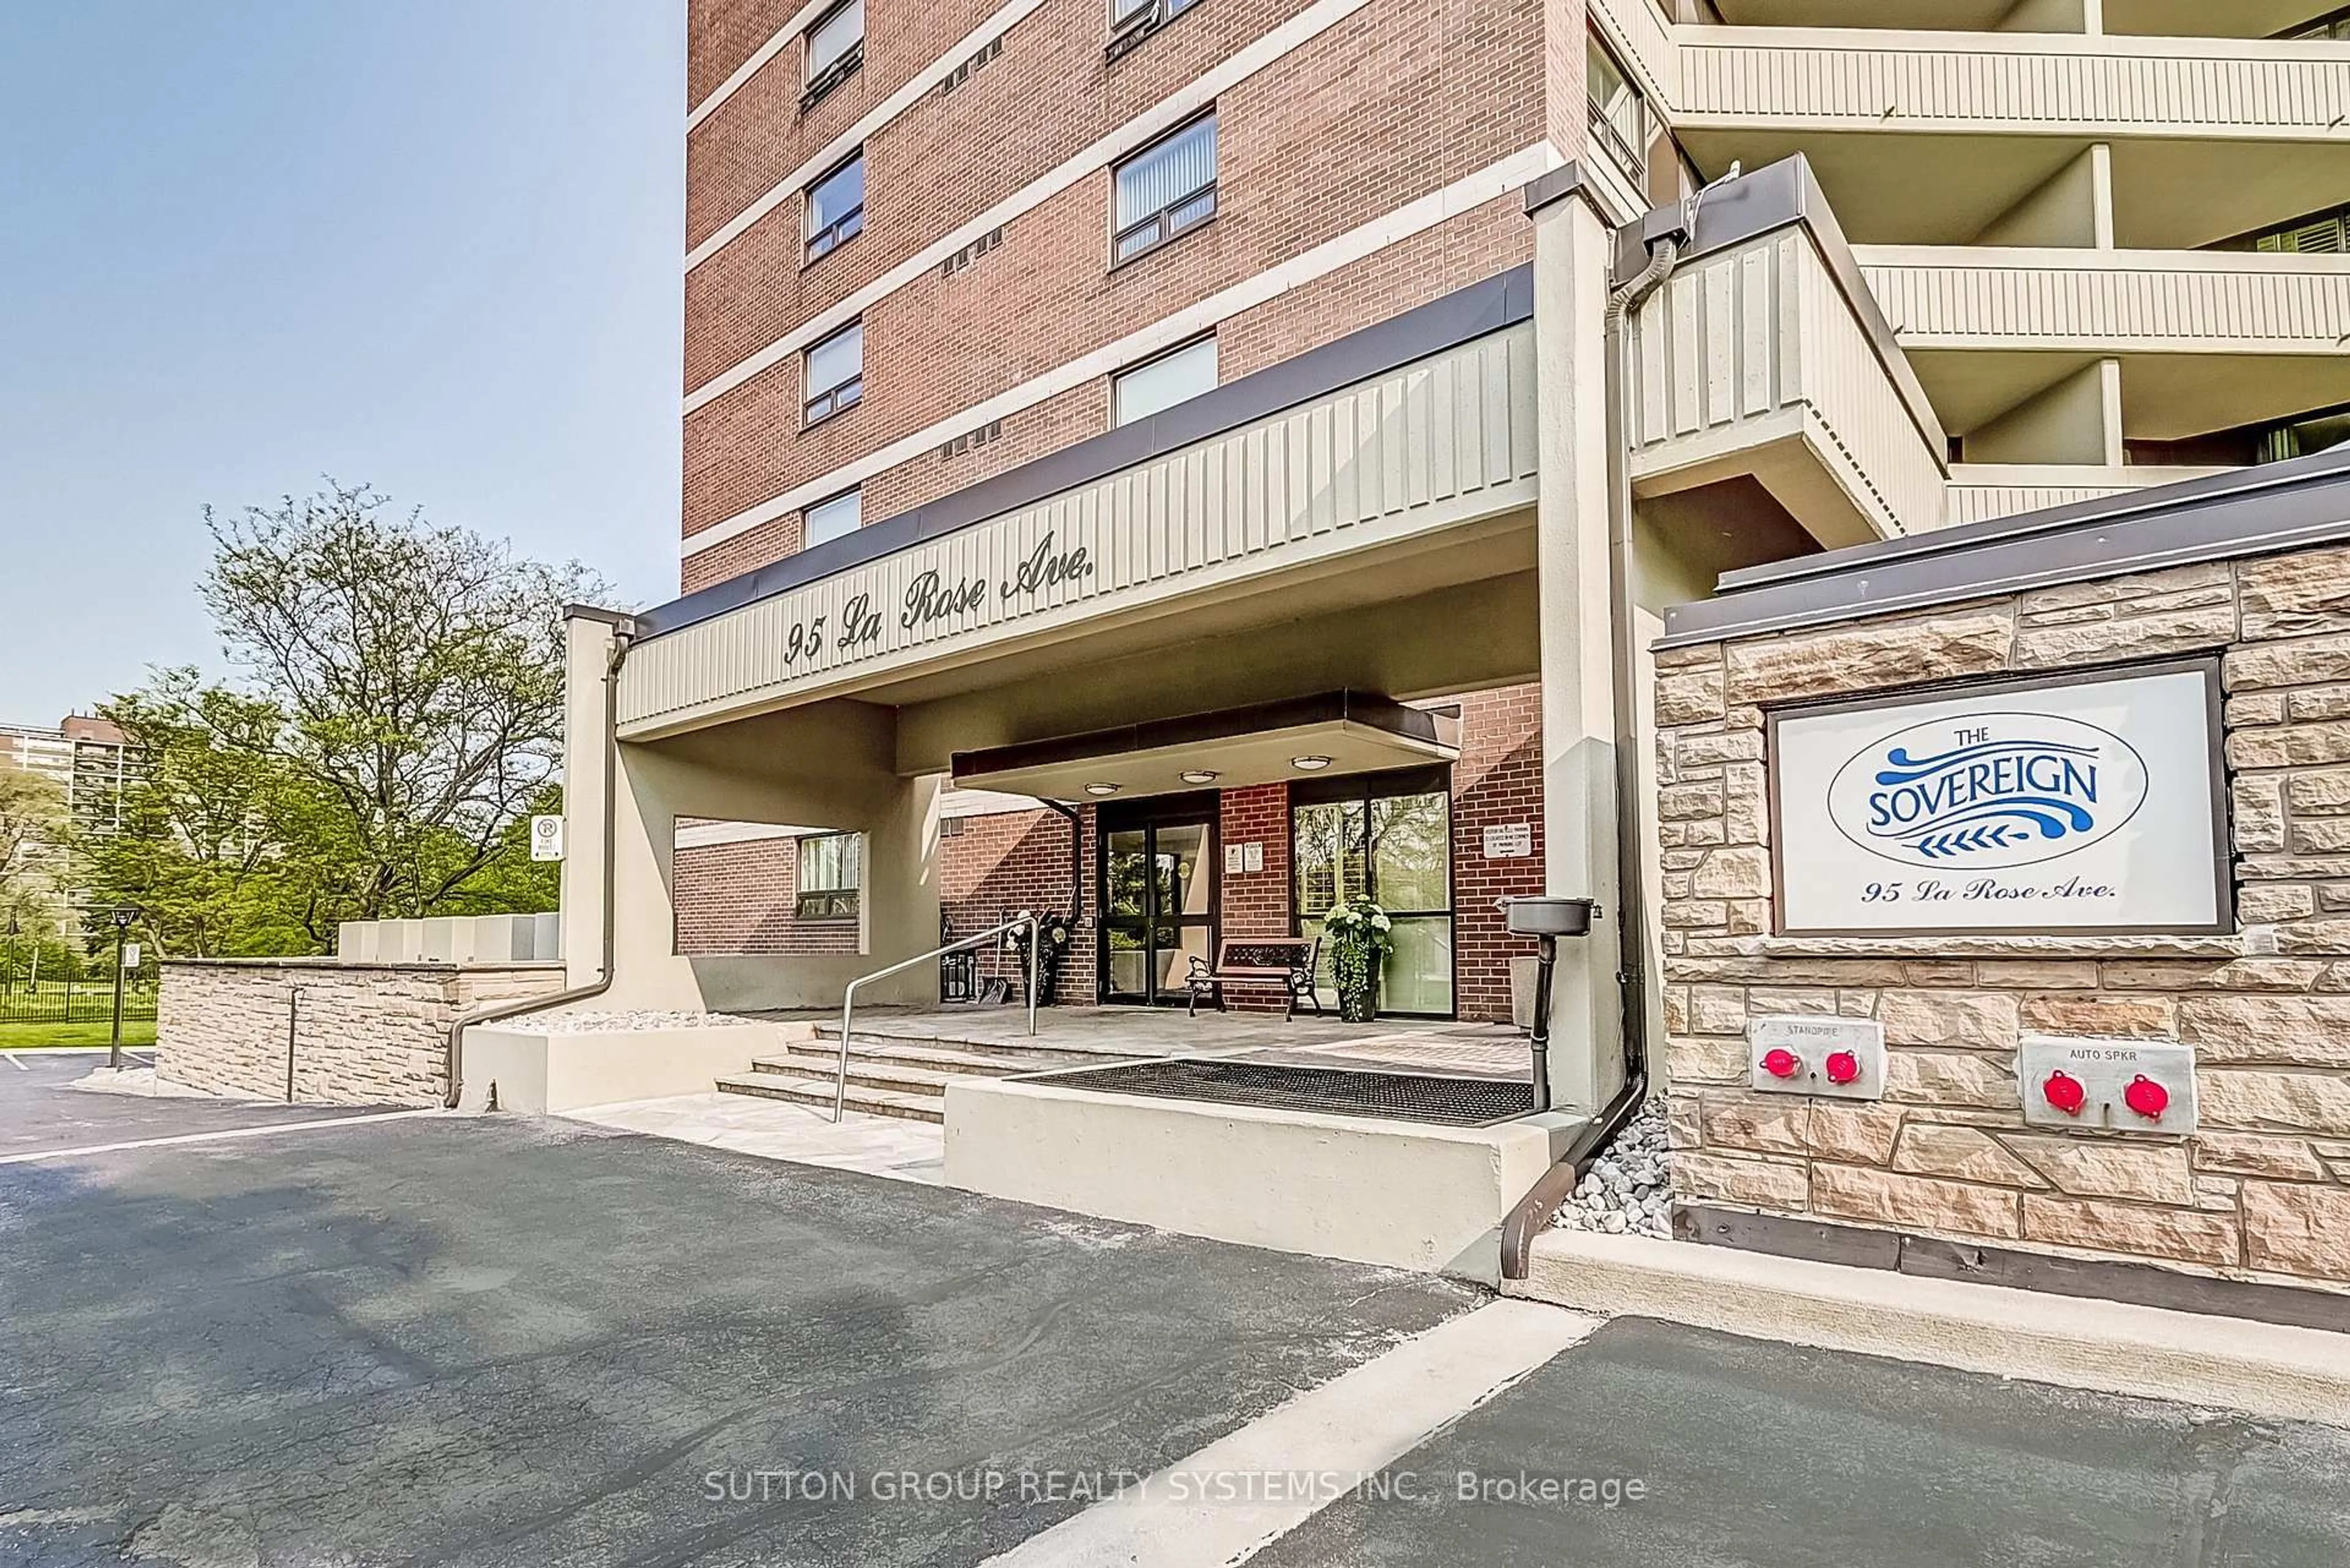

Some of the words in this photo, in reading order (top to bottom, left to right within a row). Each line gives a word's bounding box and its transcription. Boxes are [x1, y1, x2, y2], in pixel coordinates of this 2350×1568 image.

[784, 616, 825, 665] 95
[837, 592, 882, 648] La
[901, 569, 987, 629] Rose
[1001, 530, 1093, 598] Ave.
[1953, 726, 1990, 746] THE
[1868, 755, 2098, 827] SOVEREIGN
[1861, 882, 1903, 903] 95
[1913, 879, 1955, 902] La
[1962, 877, 2040, 900] Rose
[2042, 875, 2116, 899] Ave.
[2070, 1049, 2100, 1059] AUTO
[2105, 1050, 2138, 1061] SPKR
